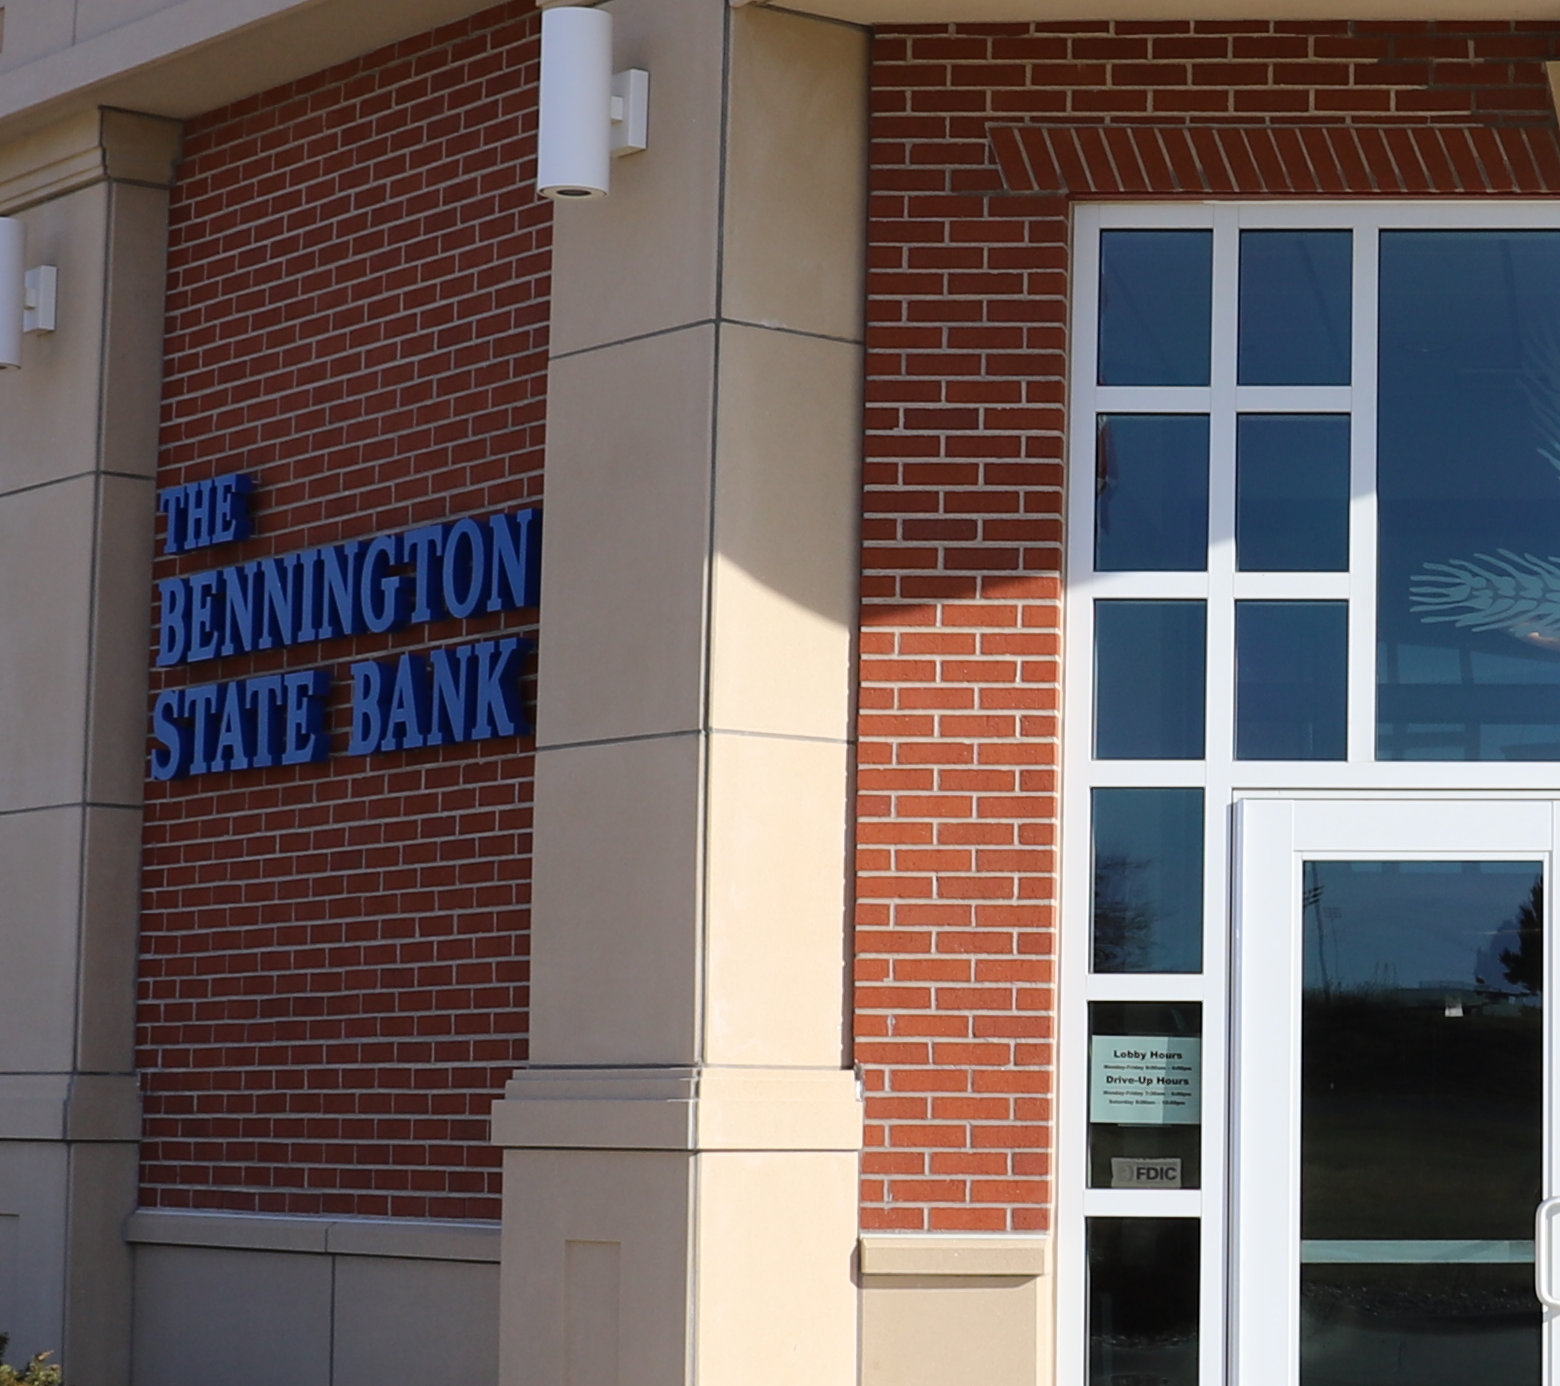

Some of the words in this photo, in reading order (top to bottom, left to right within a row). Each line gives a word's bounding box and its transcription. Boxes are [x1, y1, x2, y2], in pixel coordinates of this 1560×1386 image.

[160, 474, 251, 554] THE
[156, 508, 541, 667] BENNINGTON
[151, 670, 328, 781] STATE
[348, 638, 534, 756] BANK
[1113, 1050, 1147, 1061] Lobby
[1150, 1050, 1183, 1059] Hours
[1106, 1075, 1154, 1086] Drive-Up
[1156, 1076, 1190, 1085] Hours
[1136, 1166, 1178, 1181] FDIC
